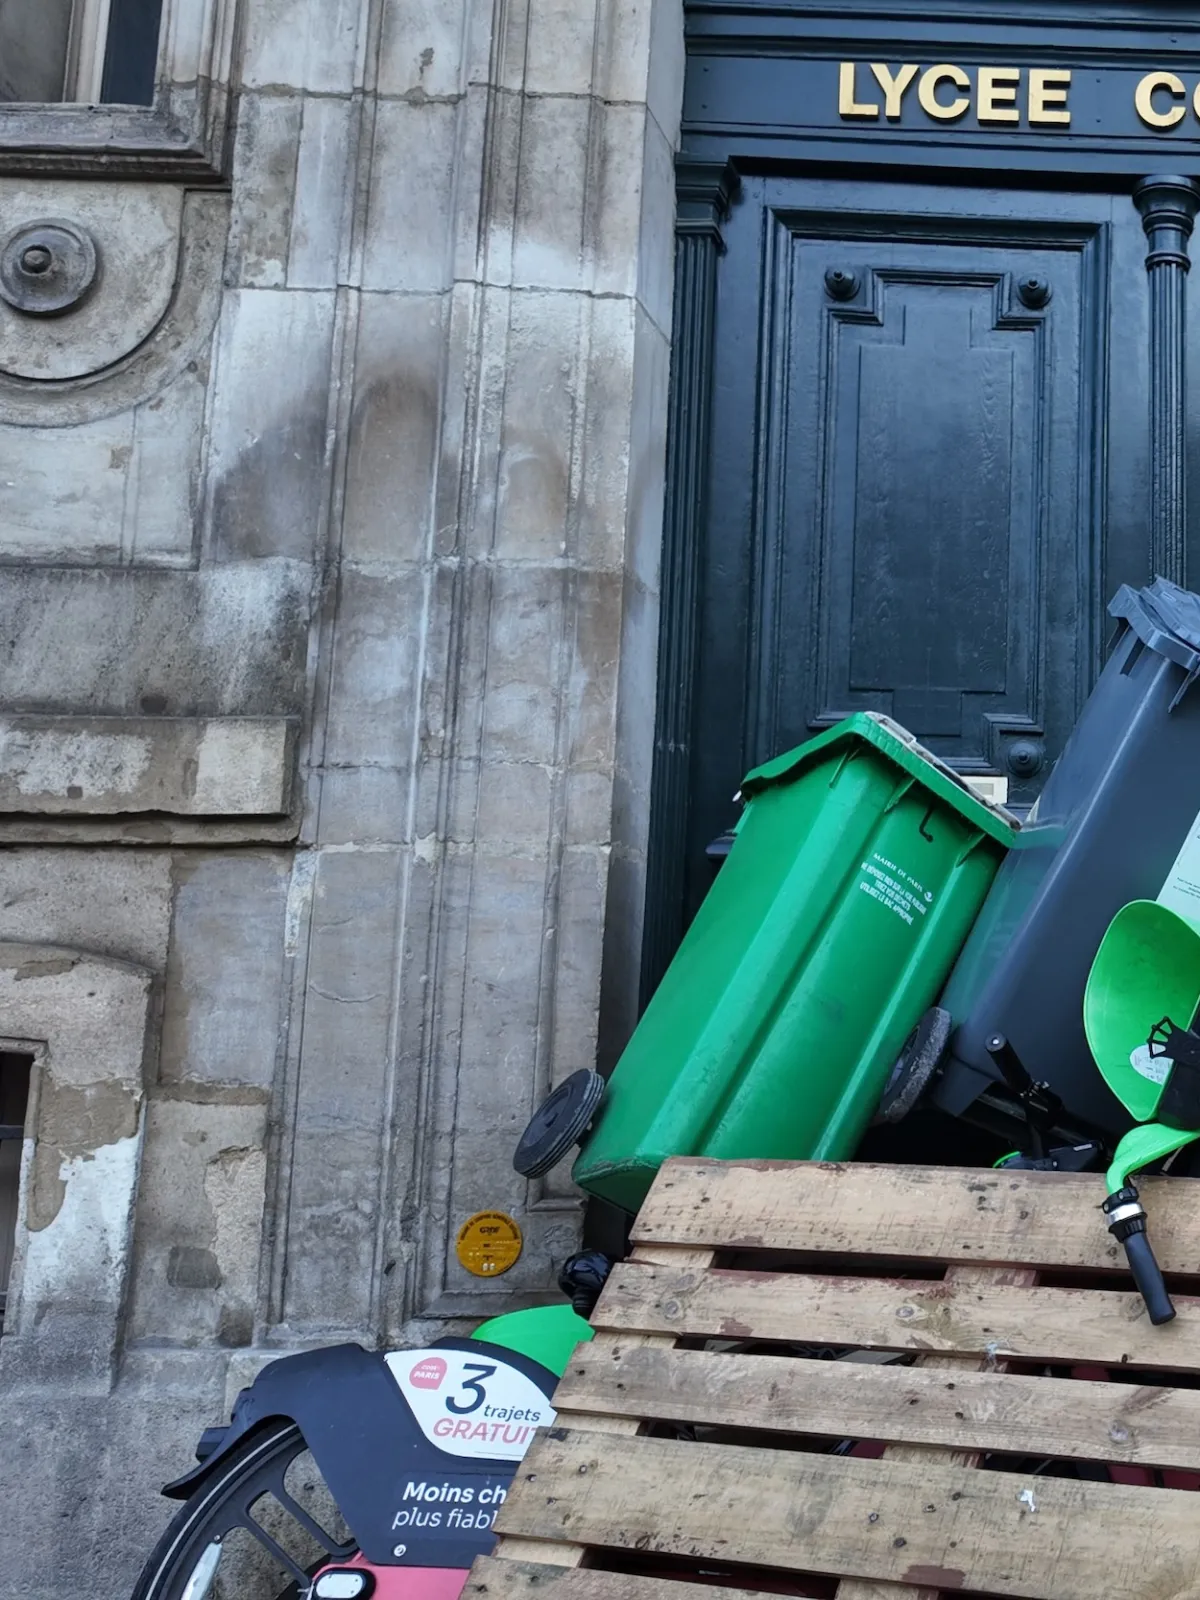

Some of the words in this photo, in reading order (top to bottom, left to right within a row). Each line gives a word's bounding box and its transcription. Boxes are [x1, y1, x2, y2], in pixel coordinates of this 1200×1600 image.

[840, 63, 1070, 122] LYCEE
[413, 1370, 440, 1380] PARIS
[445, 1363, 497, 1415] 3
[483, 1404, 541, 1422] trajets
[402, 1482, 474, 1504] Moins
[478, 1485, 507, 1504] ch
[392, 1507, 441, 1530] plus
